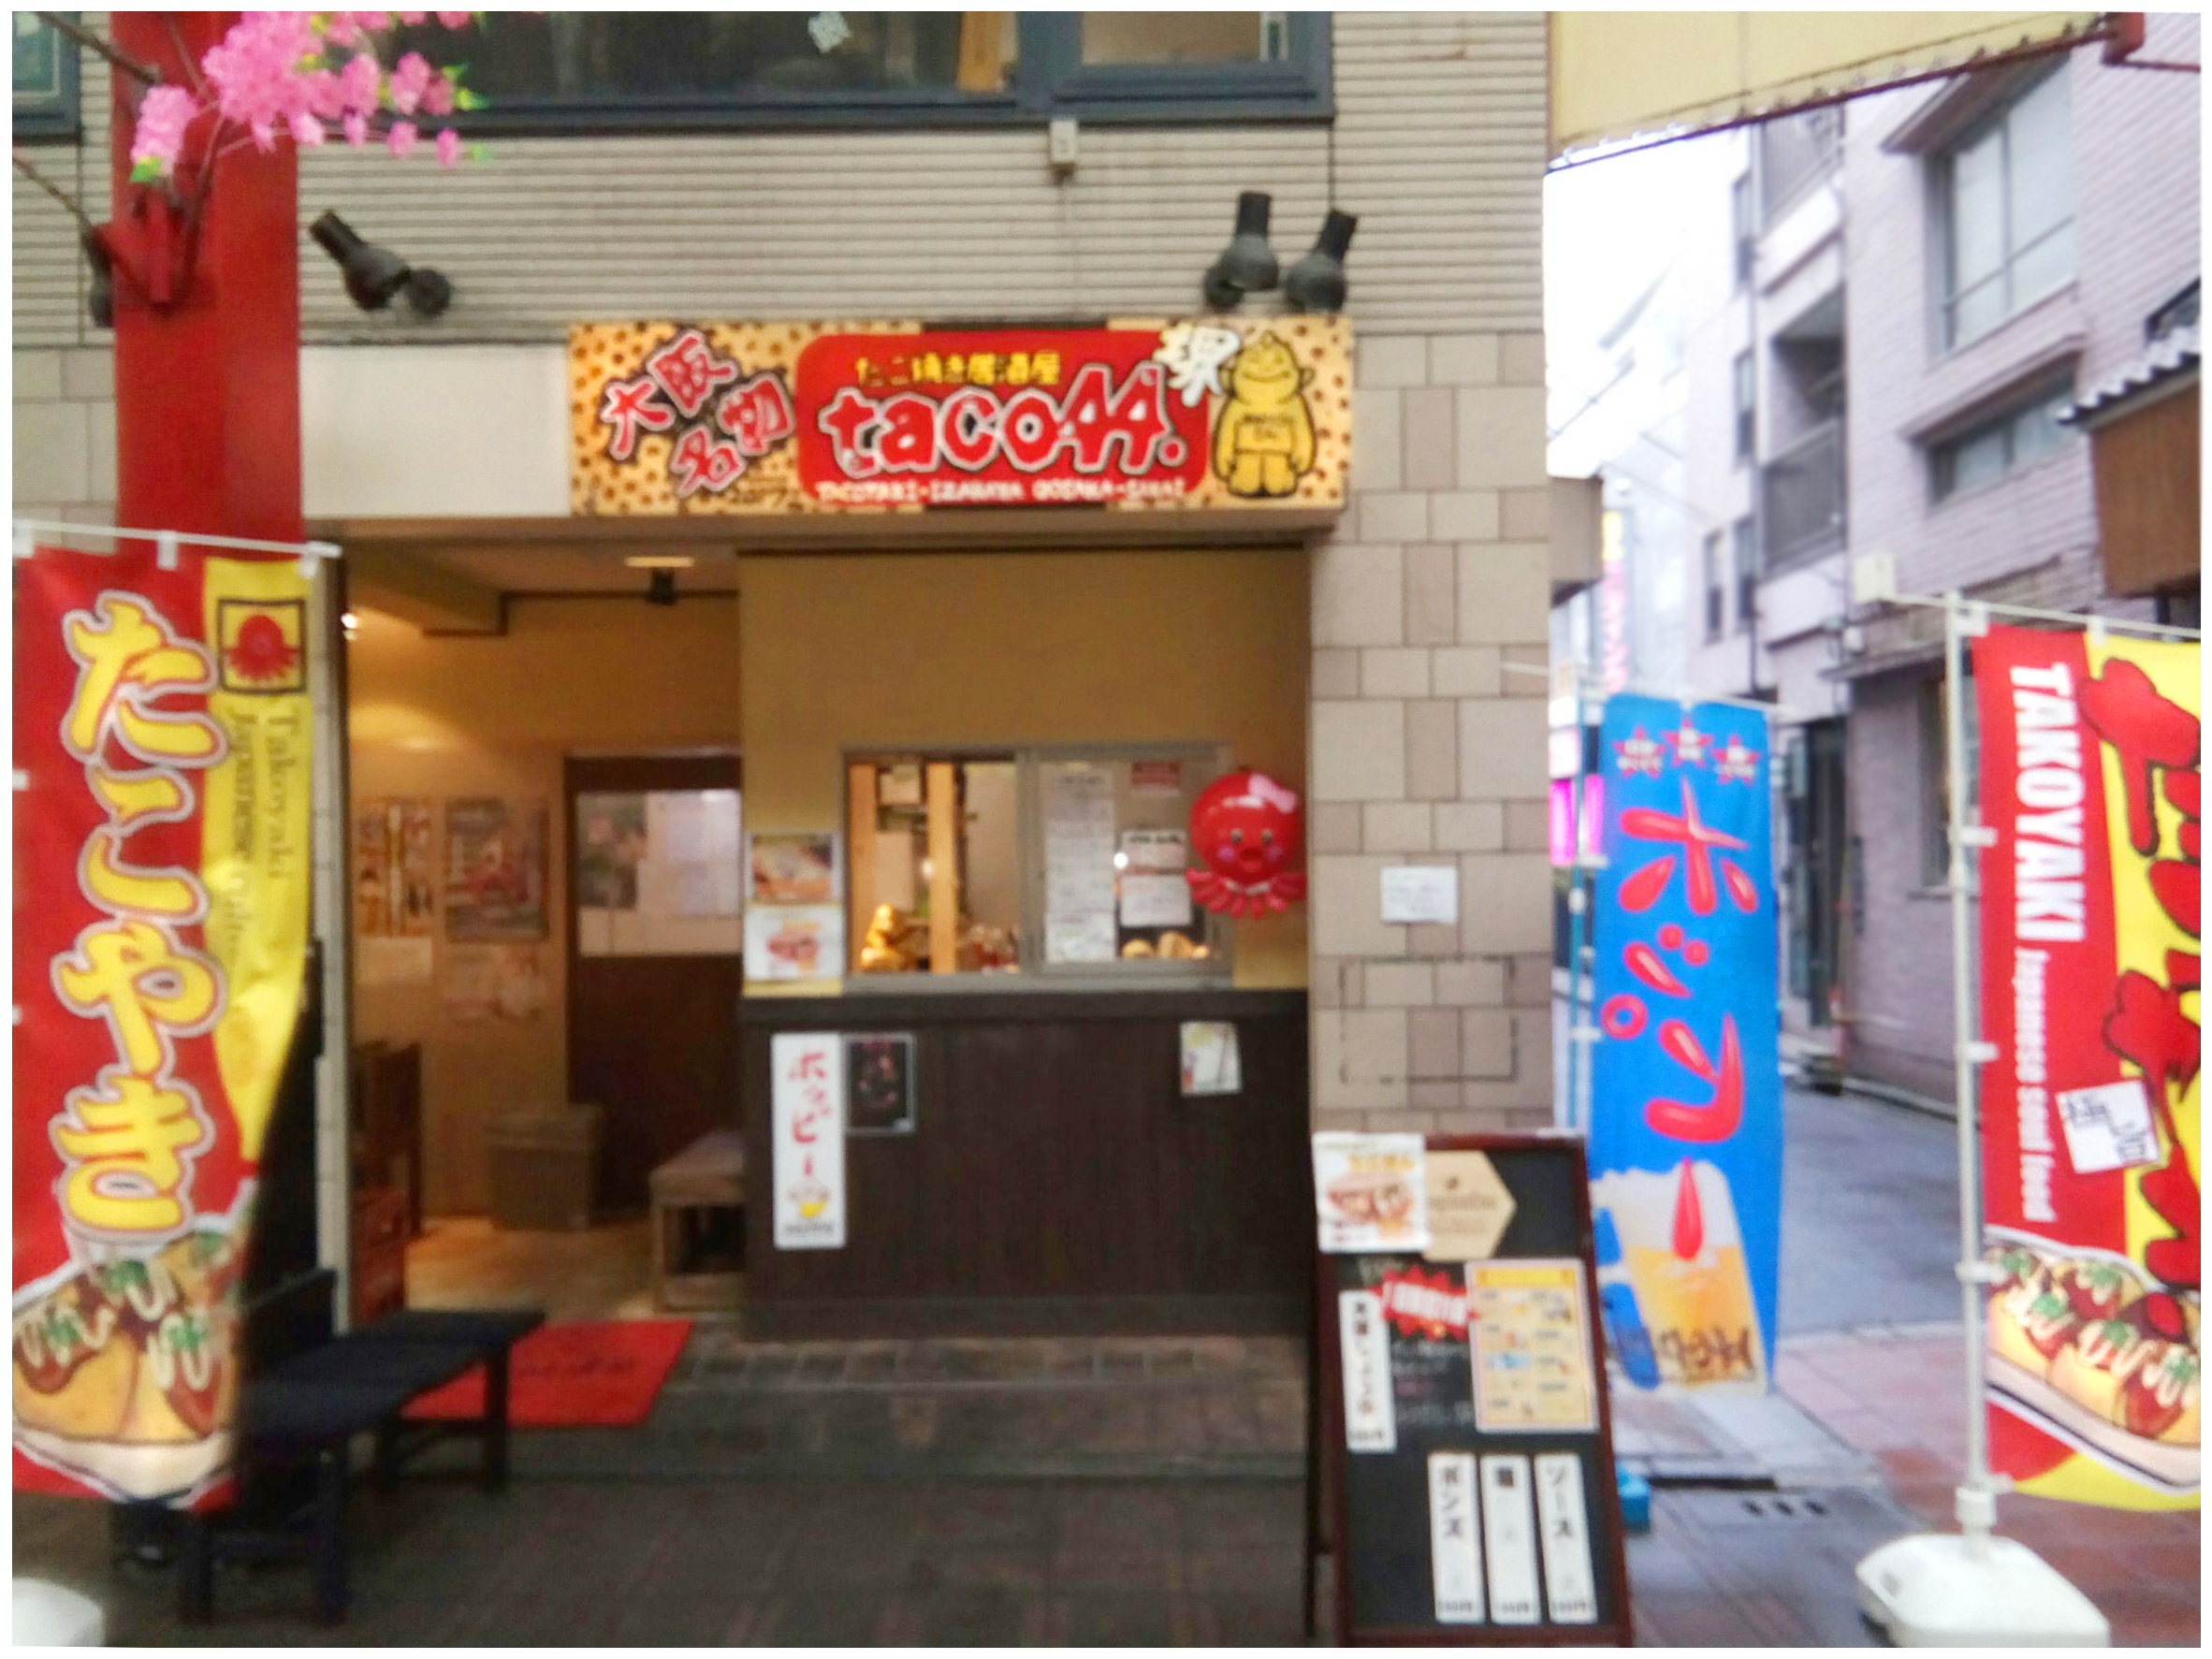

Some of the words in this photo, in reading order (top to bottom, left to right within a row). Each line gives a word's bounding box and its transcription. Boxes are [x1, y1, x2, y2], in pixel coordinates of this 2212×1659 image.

[49, 589, 227, 1238] たこやき
[2009, 661, 2086, 941] TAKOYAKI
